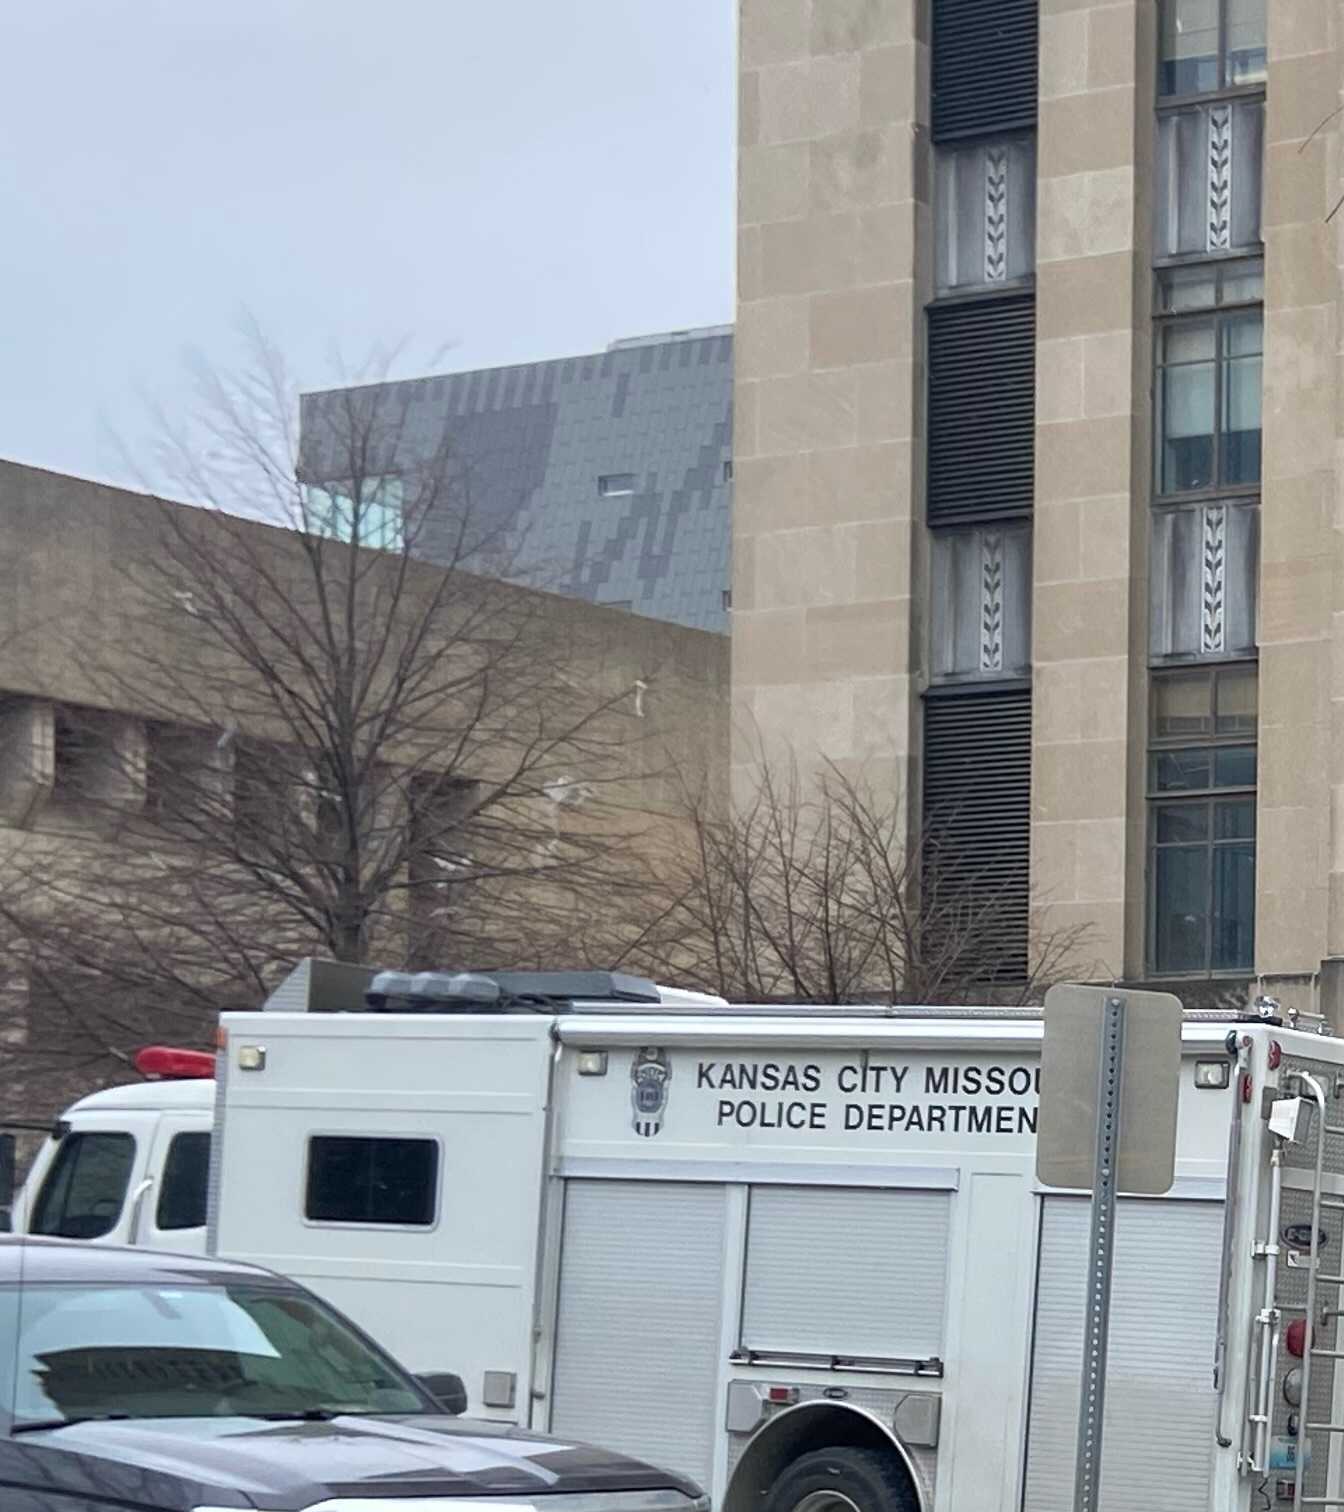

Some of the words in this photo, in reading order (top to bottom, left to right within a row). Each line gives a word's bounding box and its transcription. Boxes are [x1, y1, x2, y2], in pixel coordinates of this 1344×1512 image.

[697, 1062, 822, 1092] KANSAS
[838, 1065, 909, 1093] CITY
[717, 1099, 827, 1129] POLICE
